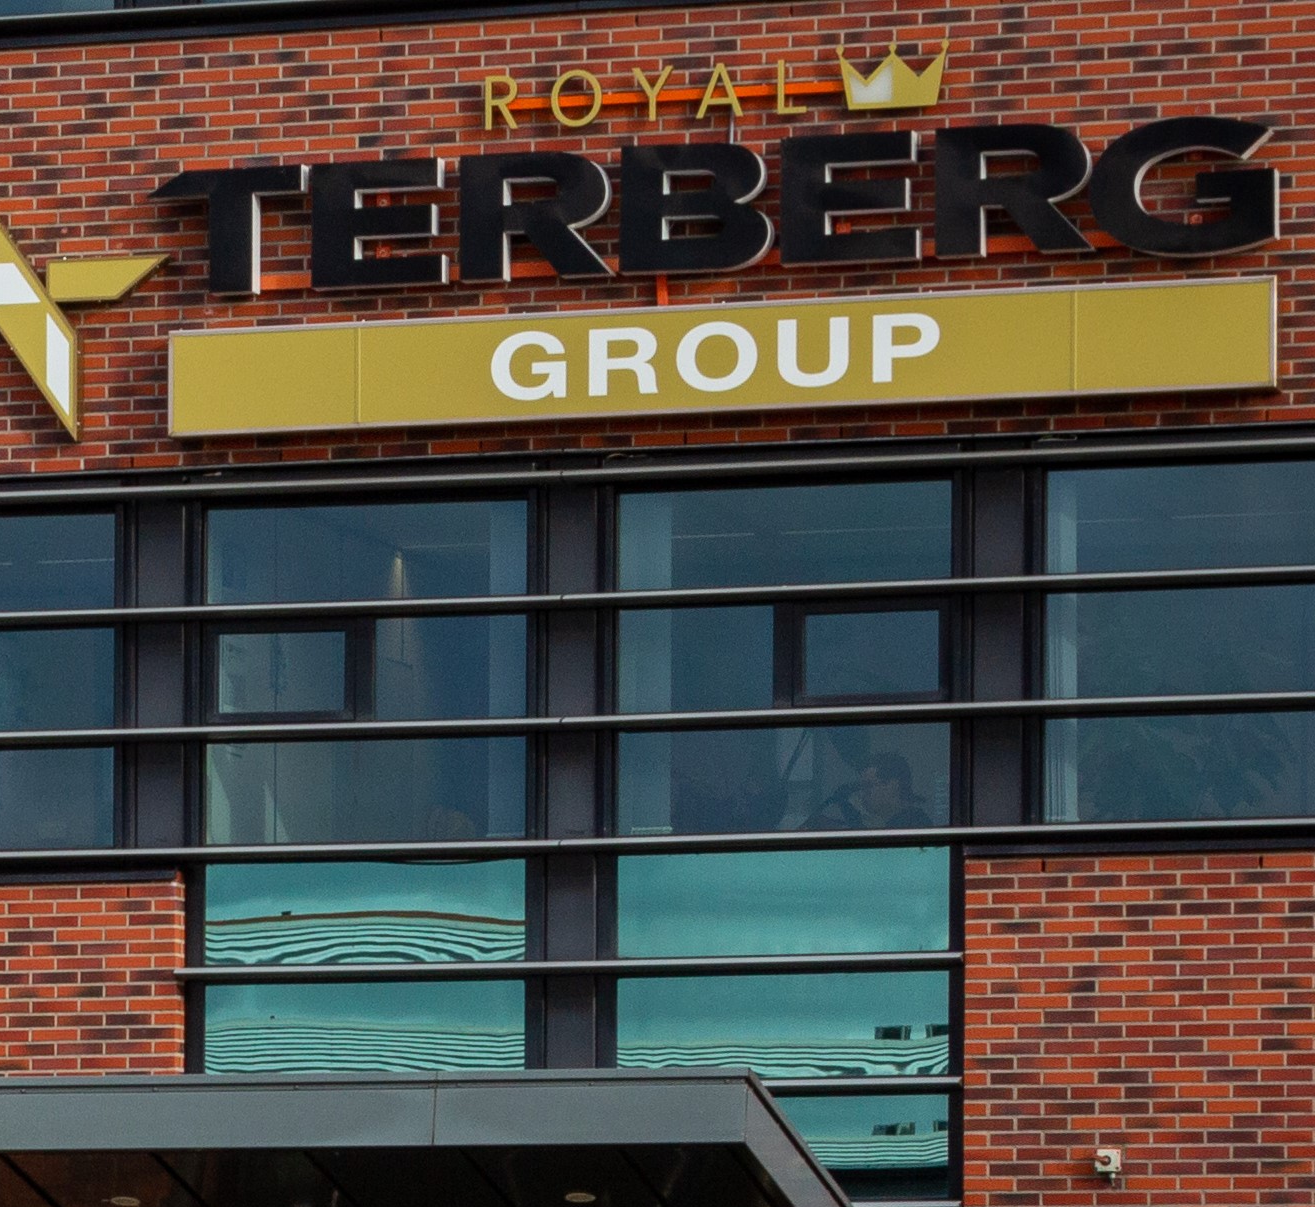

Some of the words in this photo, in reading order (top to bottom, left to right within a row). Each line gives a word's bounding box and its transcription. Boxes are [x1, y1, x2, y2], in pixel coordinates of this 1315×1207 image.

[484, 59, 807, 130] ROYAL
[147, 115, 1281, 295] TERBERG
[490, 312, 941, 401] GROUP
